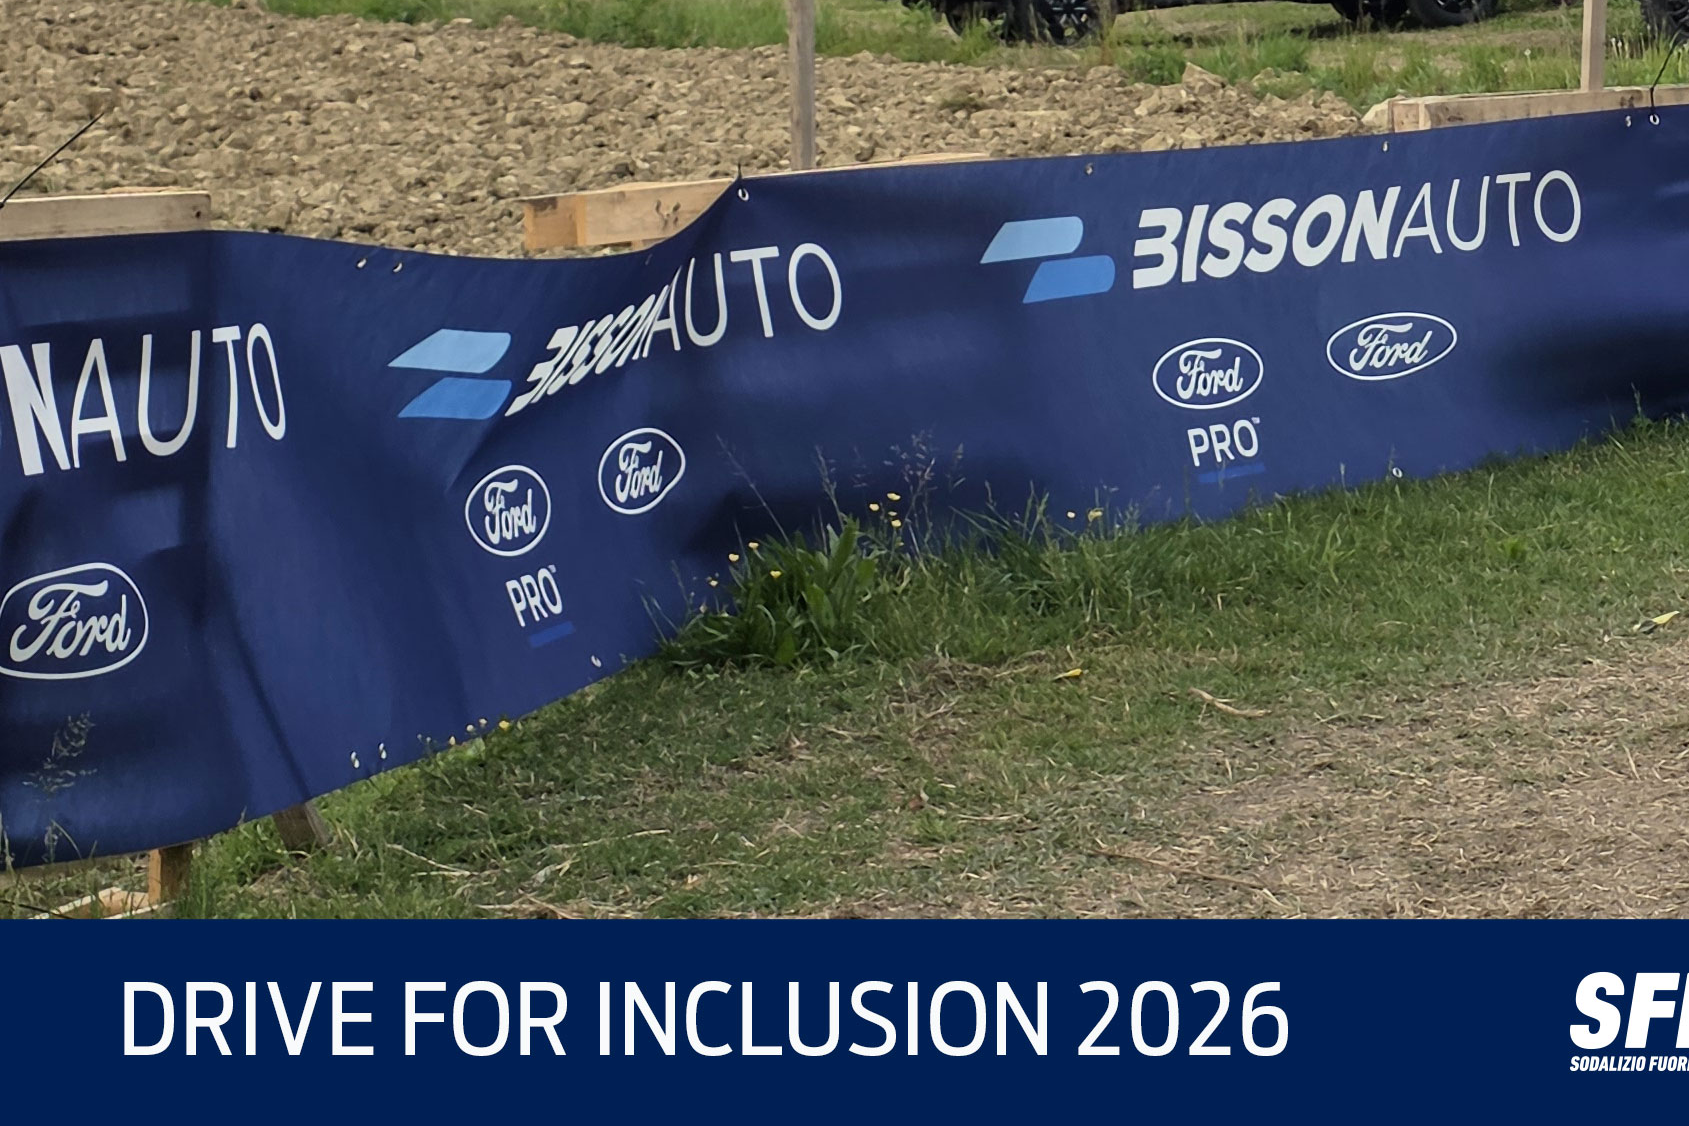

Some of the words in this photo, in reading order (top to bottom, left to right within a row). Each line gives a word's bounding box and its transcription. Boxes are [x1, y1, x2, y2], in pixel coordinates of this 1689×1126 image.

[1133, 170, 1581, 289] BISSONAUTO
[1177, 349, 1243, 397] Ford
[1349, 322, 1432, 372] Ford
[0, 323, 285, 475] NAUTO
[616, 441, 662, 503] Ford
[484, 478, 536, 545] Ford
[10, 580, 131, 662] Ford
